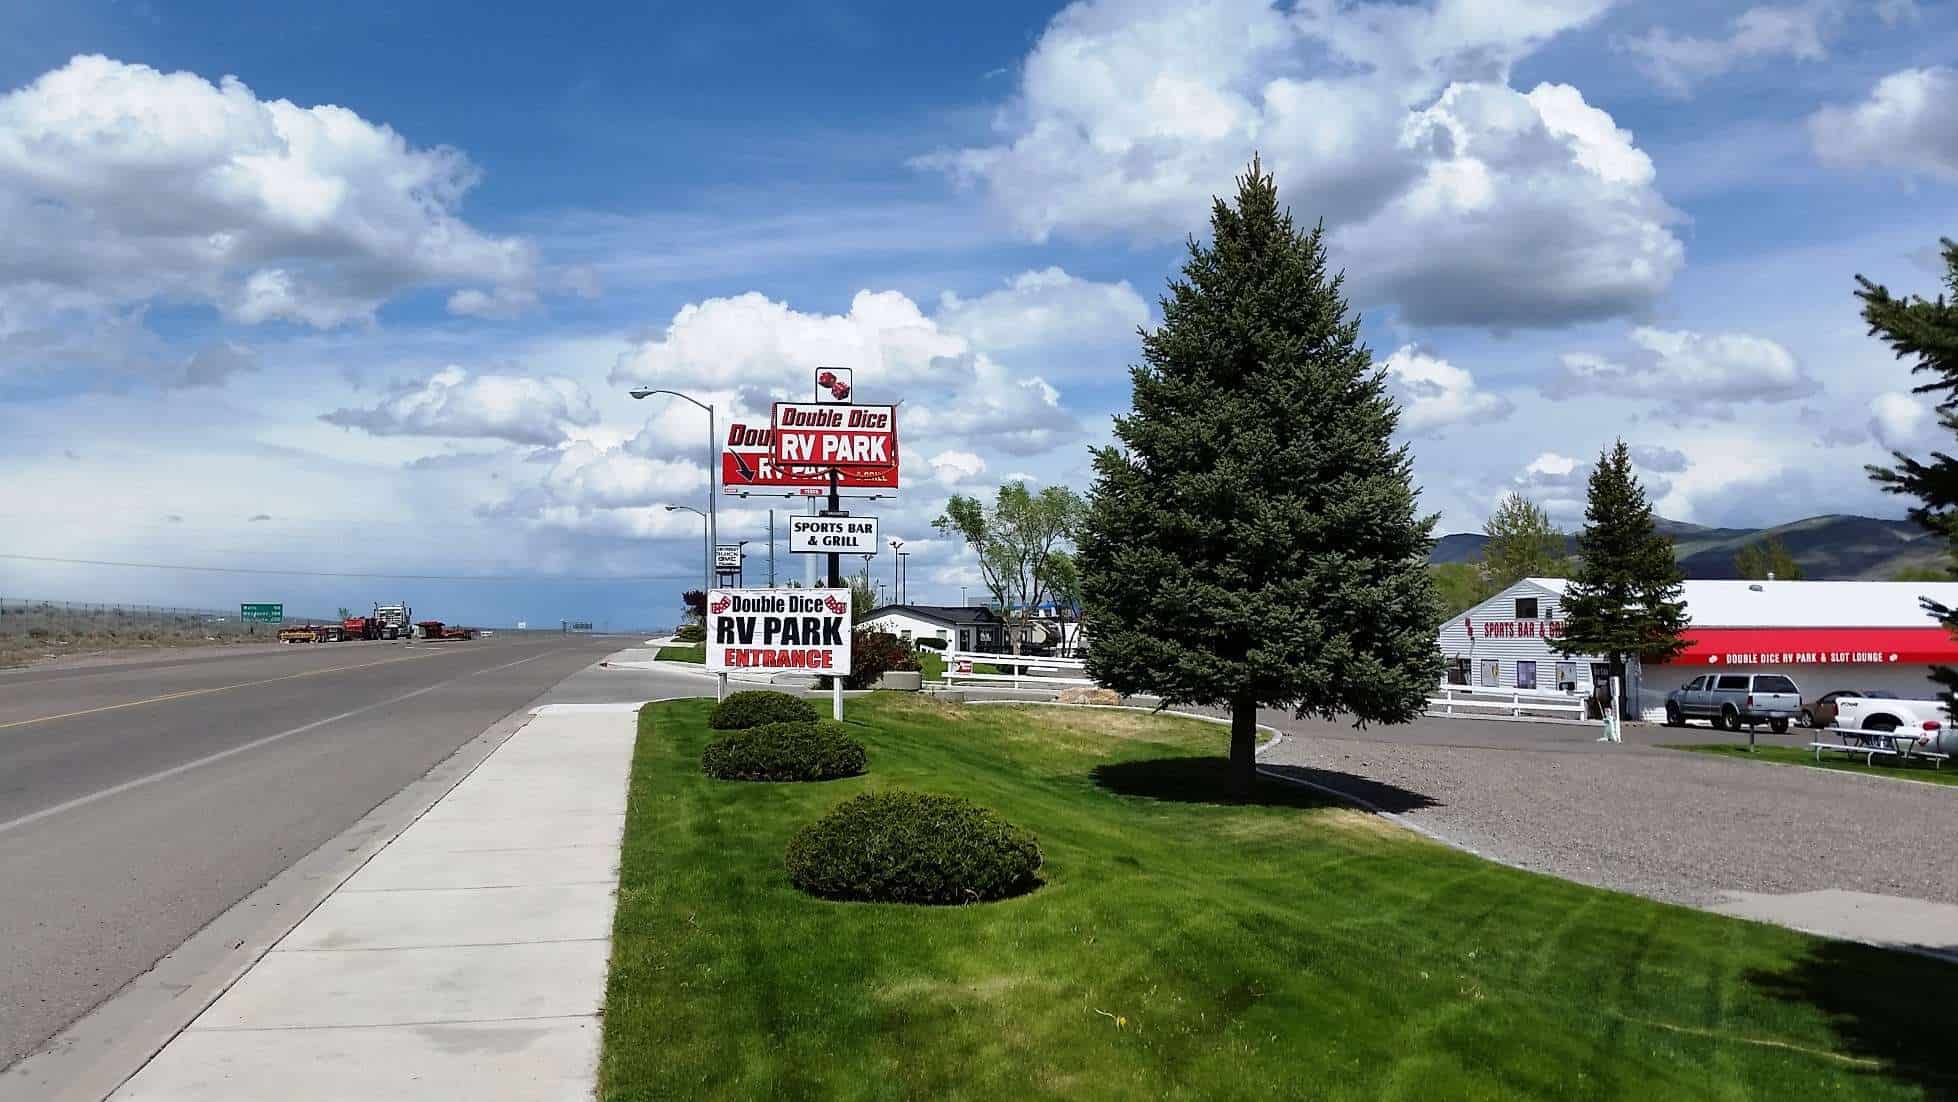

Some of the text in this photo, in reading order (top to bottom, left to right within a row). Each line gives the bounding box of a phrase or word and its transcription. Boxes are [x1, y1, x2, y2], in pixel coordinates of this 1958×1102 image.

[781, 408, 888, 428] Double Dice
[728, 424, 774, 447] Dou
[781, 433, 887, 462] RV PARK
[794, 521, 873, 534] SPORTS BAR
[807, 535, 860, 547] & GRILL
[732, 595, 824, 613] Double Dice
[716, 616, 843, 646] RV PARK
[1484, 621, 1515, 638] SPORTS
[1518, 621, 1535, 638] BAR
[1539, 621, 1546, 638] &
[724, 648, 833, 668] ENTRANCE
[1726, 652, 1883, 664] DOUBLE DICE RV PARK & SLOT LOUNGE
